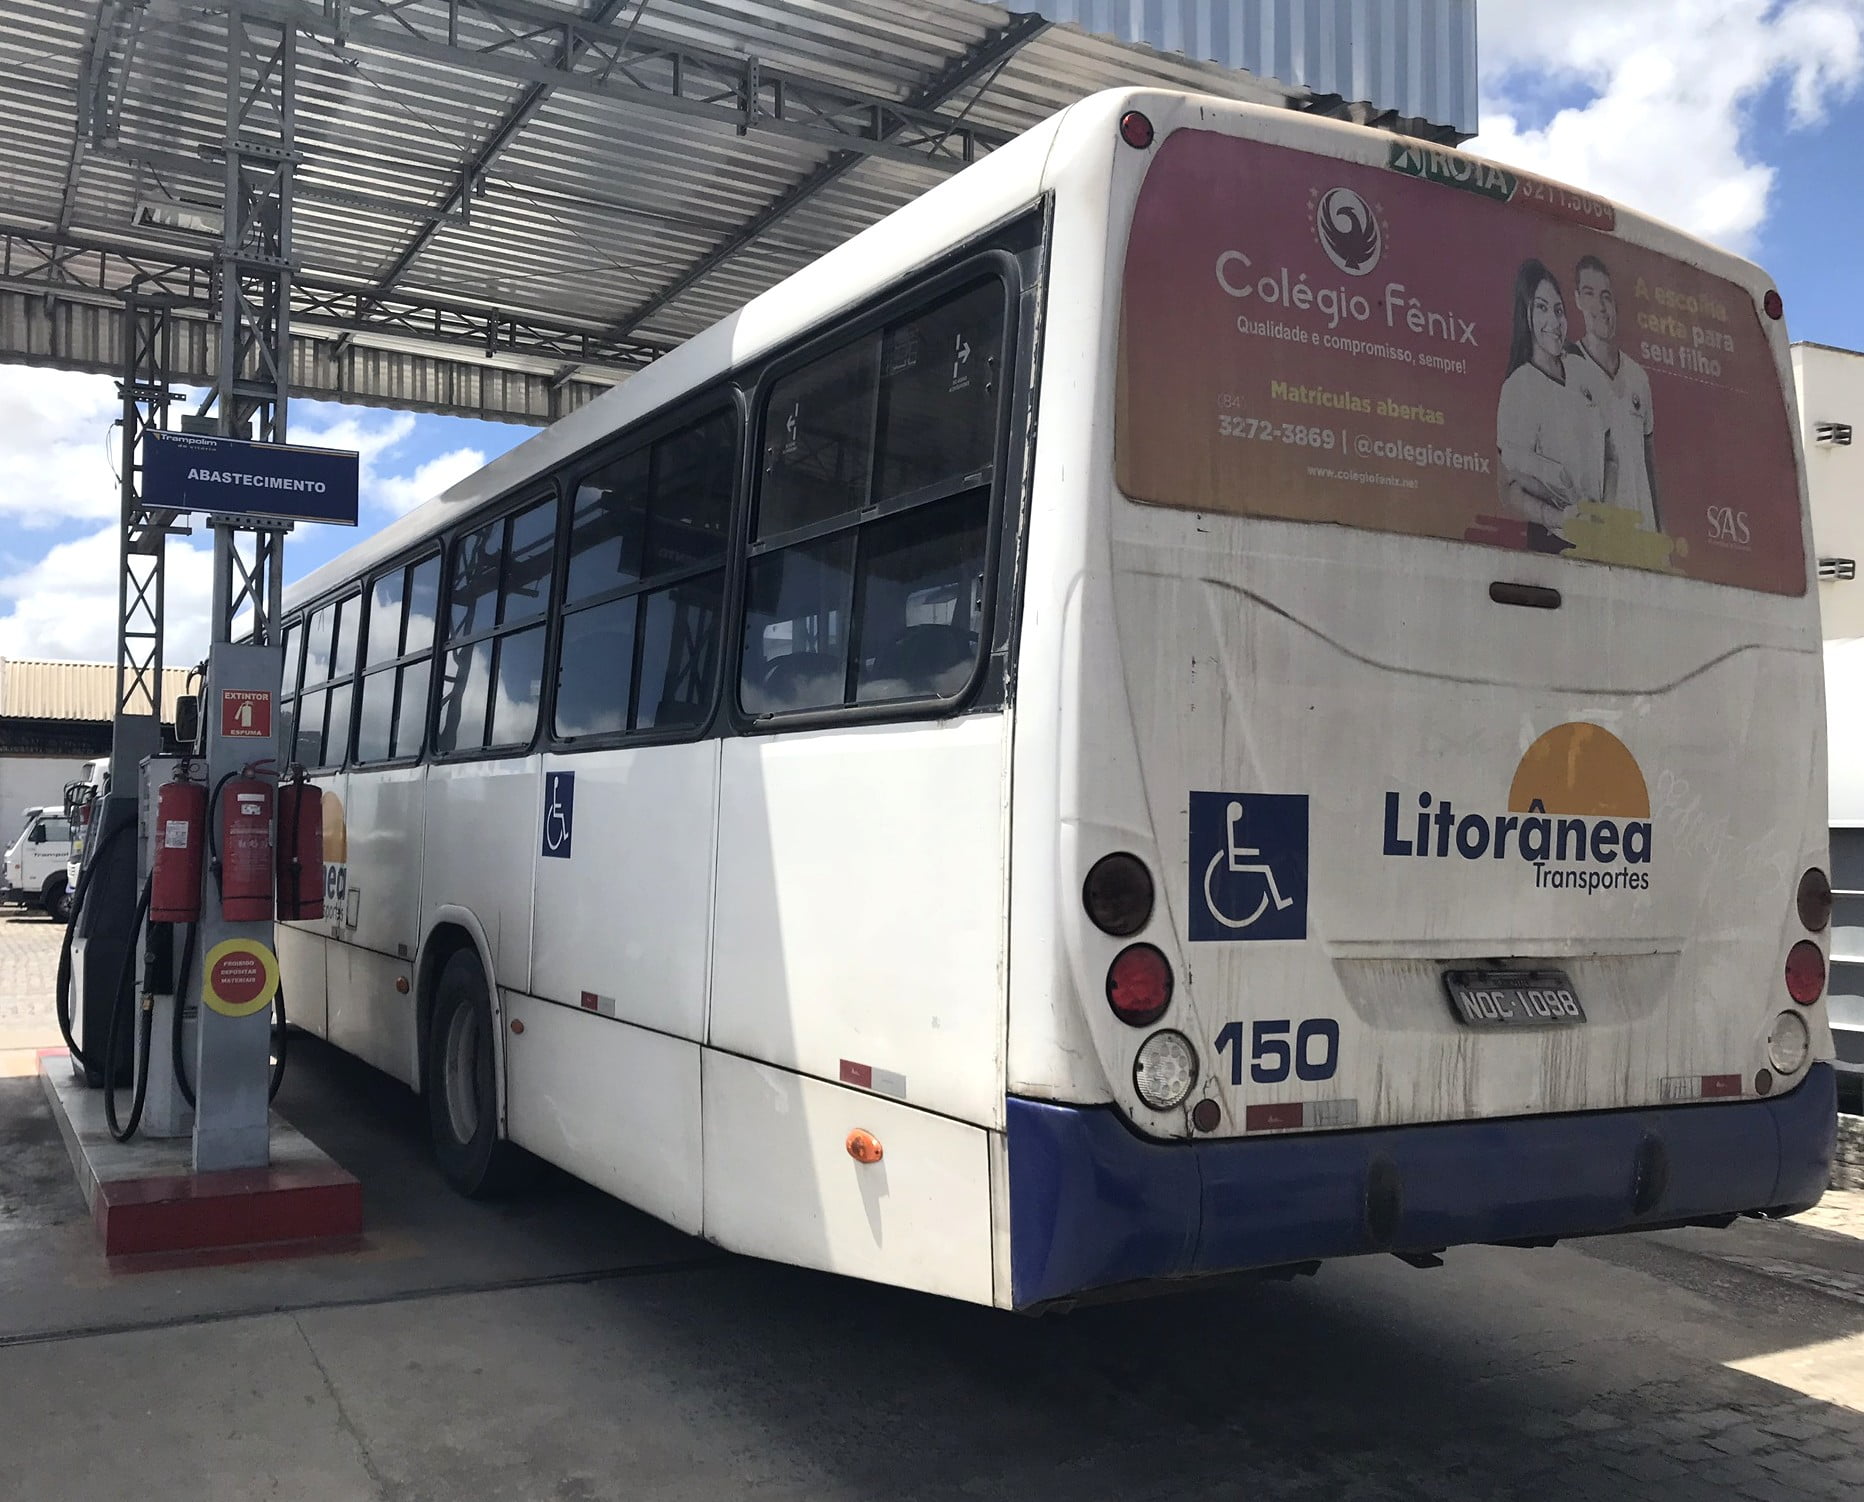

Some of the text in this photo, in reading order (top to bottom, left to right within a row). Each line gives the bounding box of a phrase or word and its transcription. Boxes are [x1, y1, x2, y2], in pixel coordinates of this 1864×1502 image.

[1429, 150, 1509, 195] ROTA
[1215, 250, 1479, 347] Colégio Fênix
[1635, 277, 1650, 301] A
[1236, 315, 1467, 375] Qualidade e compromisso, sempre!
[1637, 311, 1735, 353] certa para
[1640, 341, 1722, 378] seu filho
[1270, 379, 1445, 425] Matrículas abertas
[160, 432, 217, 447] Trampolim
[1218, 414, 1335, 450] 3272-3869
[1354, 433, 1491, 475] @colegiofenix
[187, 467, 327, 494] ABASTECIMENTO
[1706, 505, 1751, 544] SAS
[224, 691, 269, 701] EXTINTOR
[1383, 791, 1653, 864] Litorânea
[1532, 861, 1650, 896] Transportes
[220, 968, 257, 976] DEPOSITAR
[1214, 1018, 1340, 1086] 150
